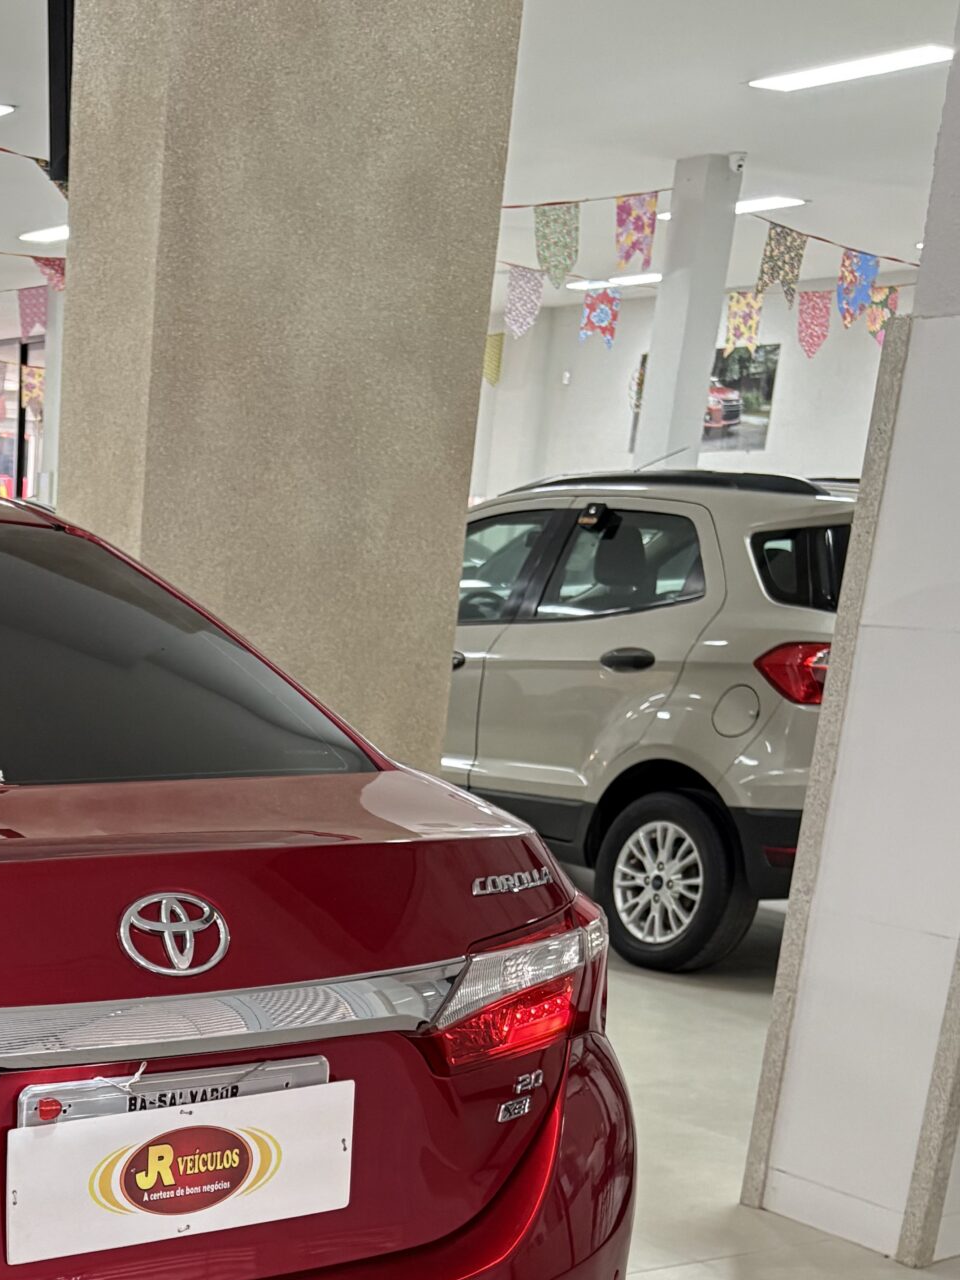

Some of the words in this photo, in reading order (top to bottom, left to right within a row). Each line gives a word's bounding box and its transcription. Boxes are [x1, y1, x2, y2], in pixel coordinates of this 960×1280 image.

[472, 866, 553, 896] COROLLA
[135, 1143, 176, 1190] JR
[177, 1149, 240, 1176] VEÍCULOS
[143, 1191, 149, 1202] A
[150, 1189, 175, 1201] certeza
[176, 1187, 185, 1197] de
[185, 1184, 202, 1195] bons
[202, 1180, 231, 1193] negócios
